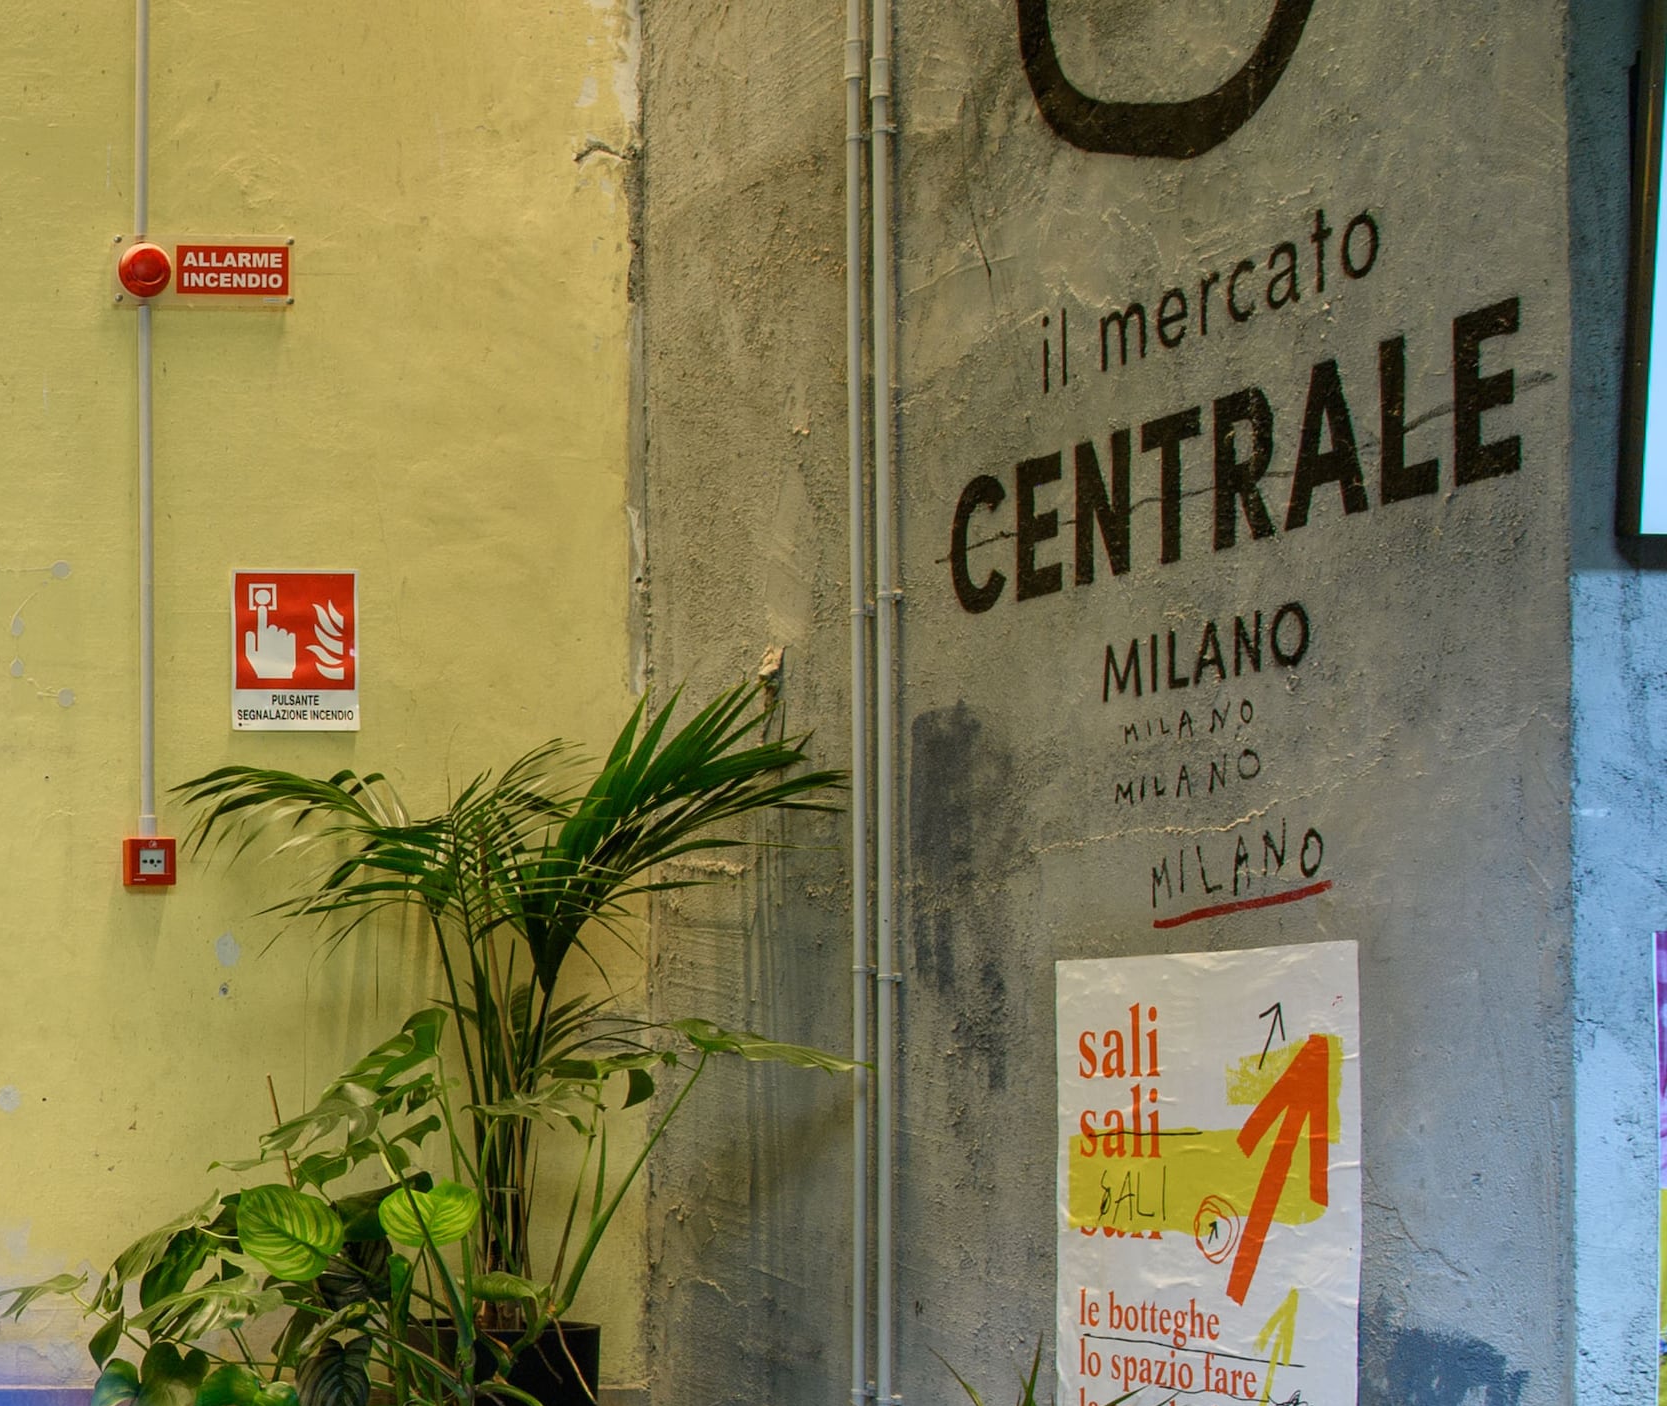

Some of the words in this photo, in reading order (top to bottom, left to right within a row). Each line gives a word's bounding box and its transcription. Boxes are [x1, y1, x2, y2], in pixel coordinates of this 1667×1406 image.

[182, 251, 283, 269] ALLARME
[182, 272, 284, 289] INCENDIO
[1041, 306, 1068, 395] il
[1098, 208, 1380, 373] mercato
[949, 296, 1523, 615] CENTRALE
[1102, 600, 1311, 704] MILANO
[236, 709, 308, 721] SEGNALAZIONE
[309, 709, 355, 721] INCENDIO
[271, 694, 320, 706] PULSANTE
[1123, 698, 1254, 745] MILANO
[1114, 748, 1261, 806] MILANO
[1151, 816, 1324, 909] MILANO
[1078, 1002, 1161, 1079] sali
[1079, 1083, 1162, 1159] sali
[1078, 1287, 1100, 1327] le
[1108, 1290, 1220, 1349] botteghe
[1078, 1336, 1101, 1378] lo
[1110, 1350, 1194, 1392] spazio
[1203, 1352, 1258, 1399] fare
